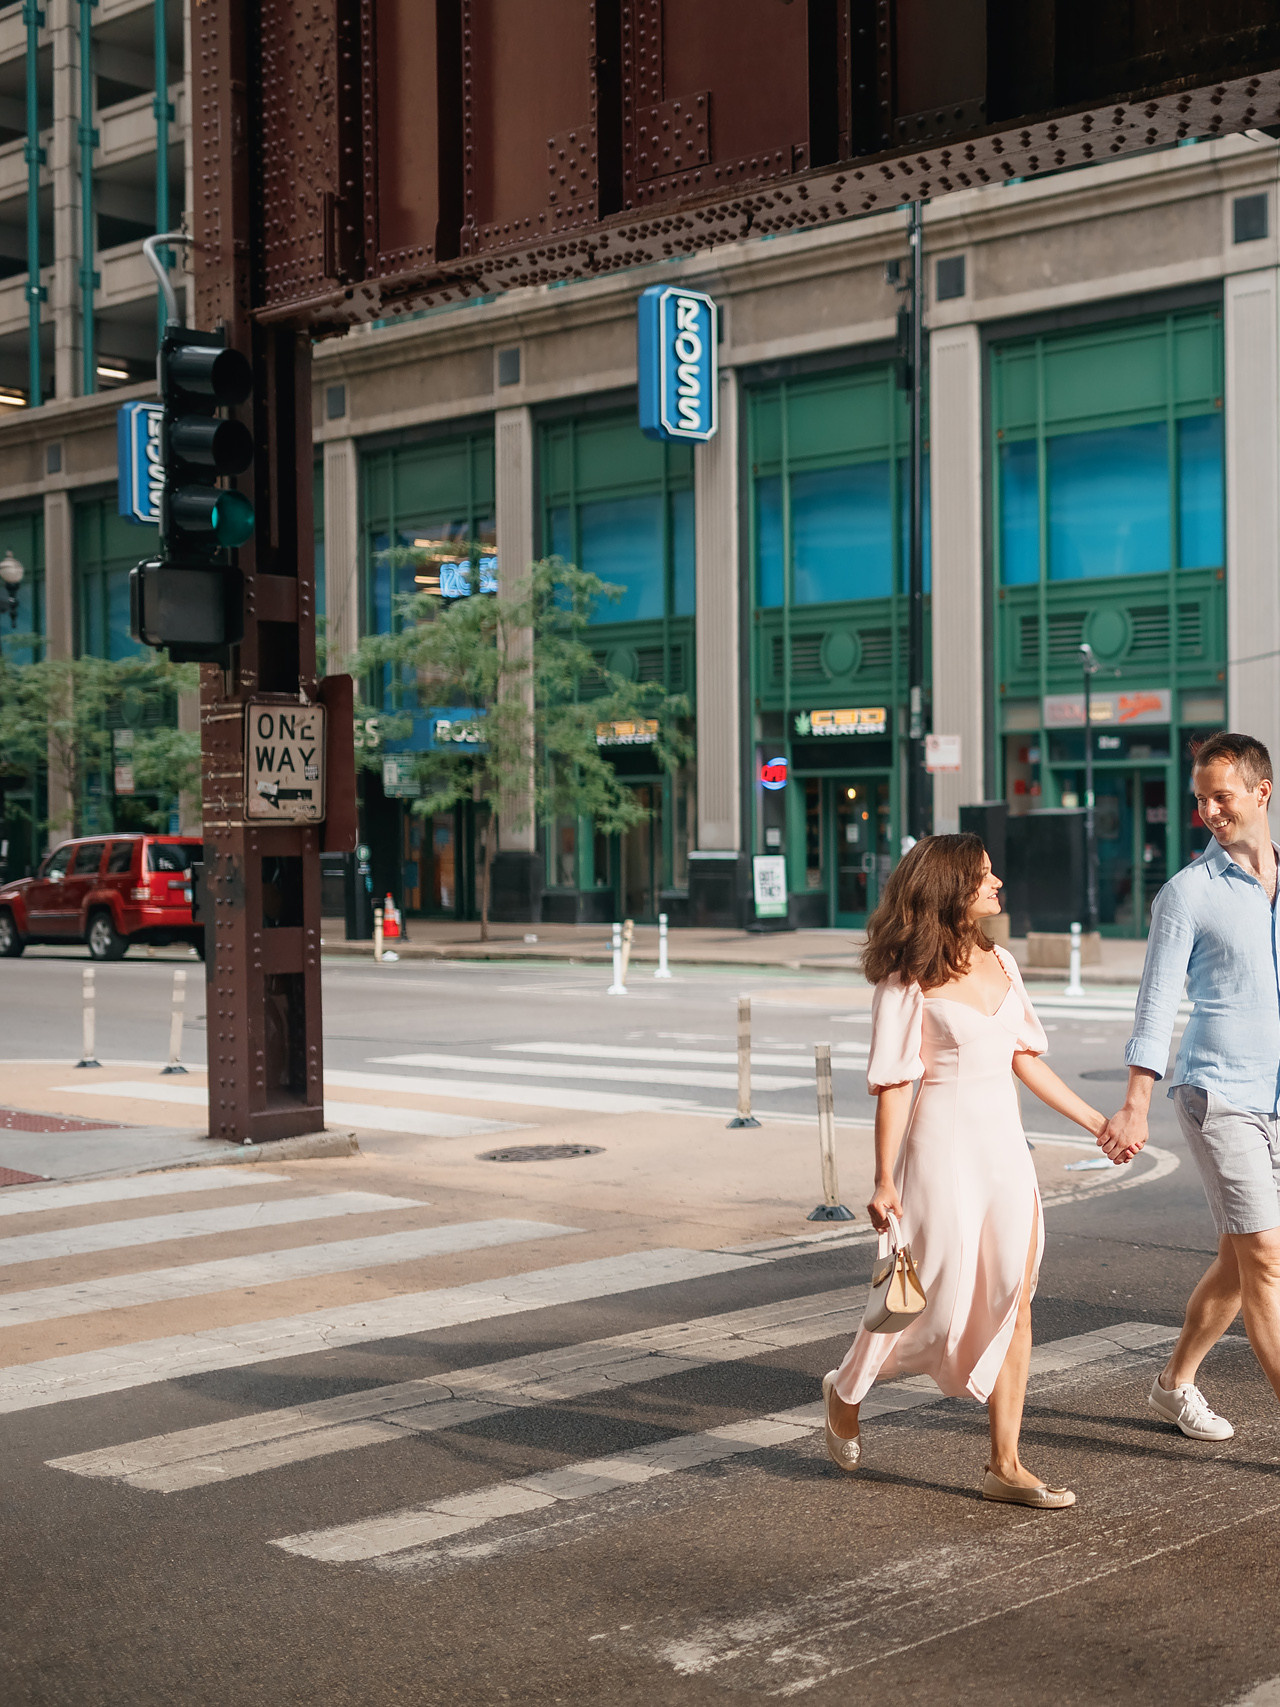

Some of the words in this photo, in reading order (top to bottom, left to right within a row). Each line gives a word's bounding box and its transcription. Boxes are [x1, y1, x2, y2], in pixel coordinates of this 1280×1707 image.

[675, 297, 702, 430] ROSS
[257, 712, 315, 740] ONE
[255, 745, 316, 773] WAY
